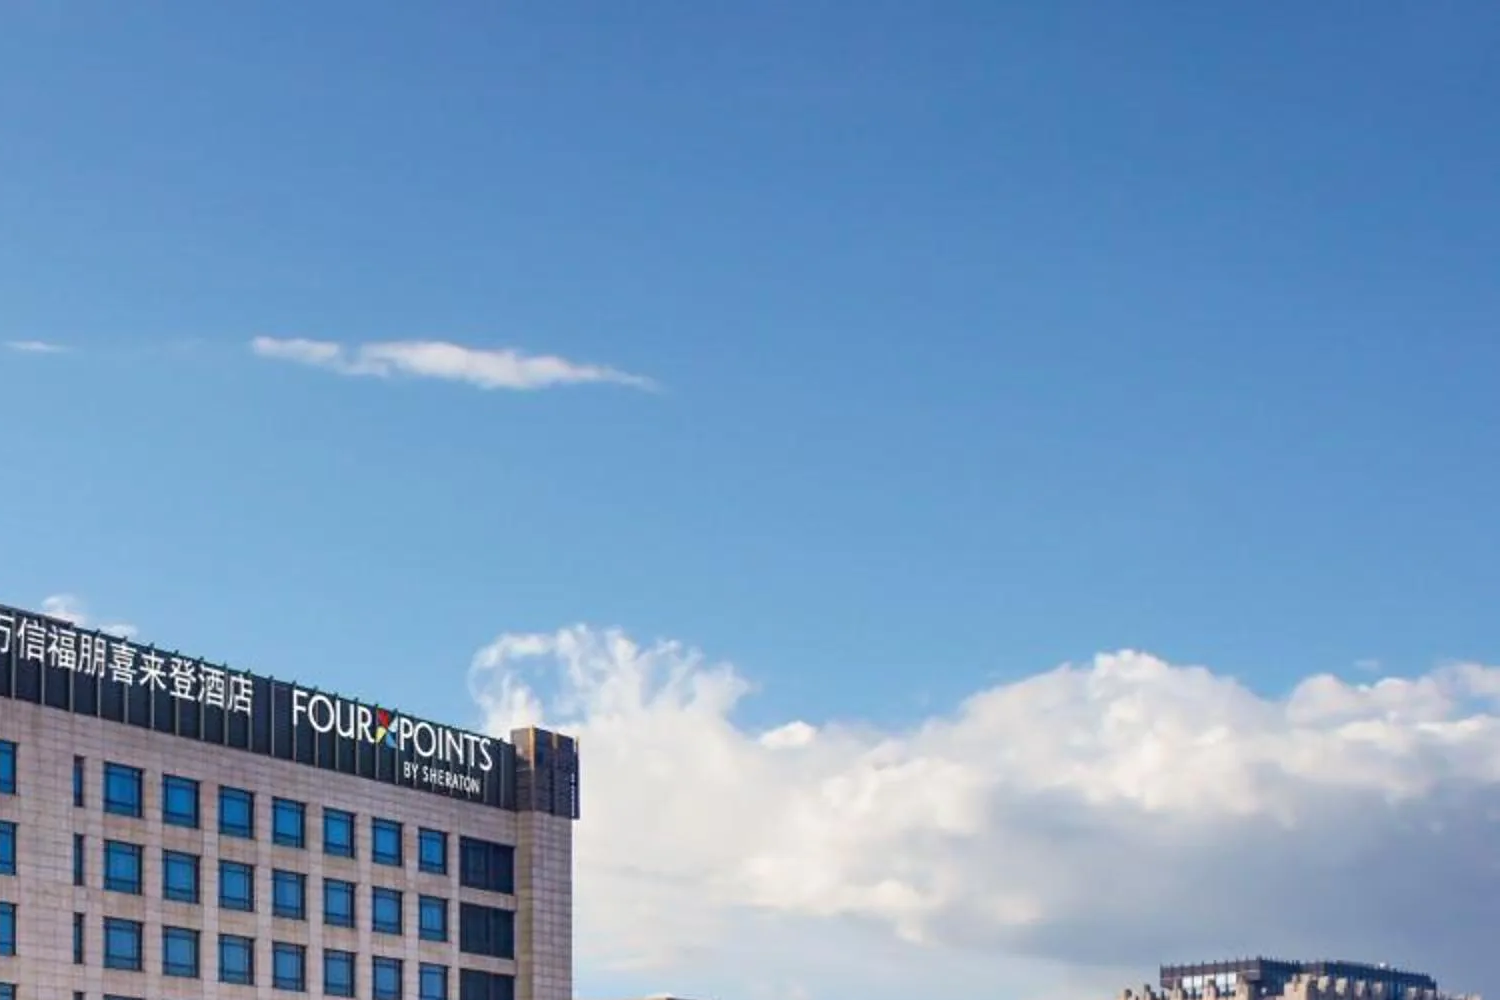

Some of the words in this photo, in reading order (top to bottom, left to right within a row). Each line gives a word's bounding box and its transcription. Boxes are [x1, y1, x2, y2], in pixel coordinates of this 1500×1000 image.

[292, 689, 376, 744] FOUR
[399, 716, 494, 771] POINTS
[403, 761, 419, 781] BY
[422, 765, 481, 793] SHERATON
